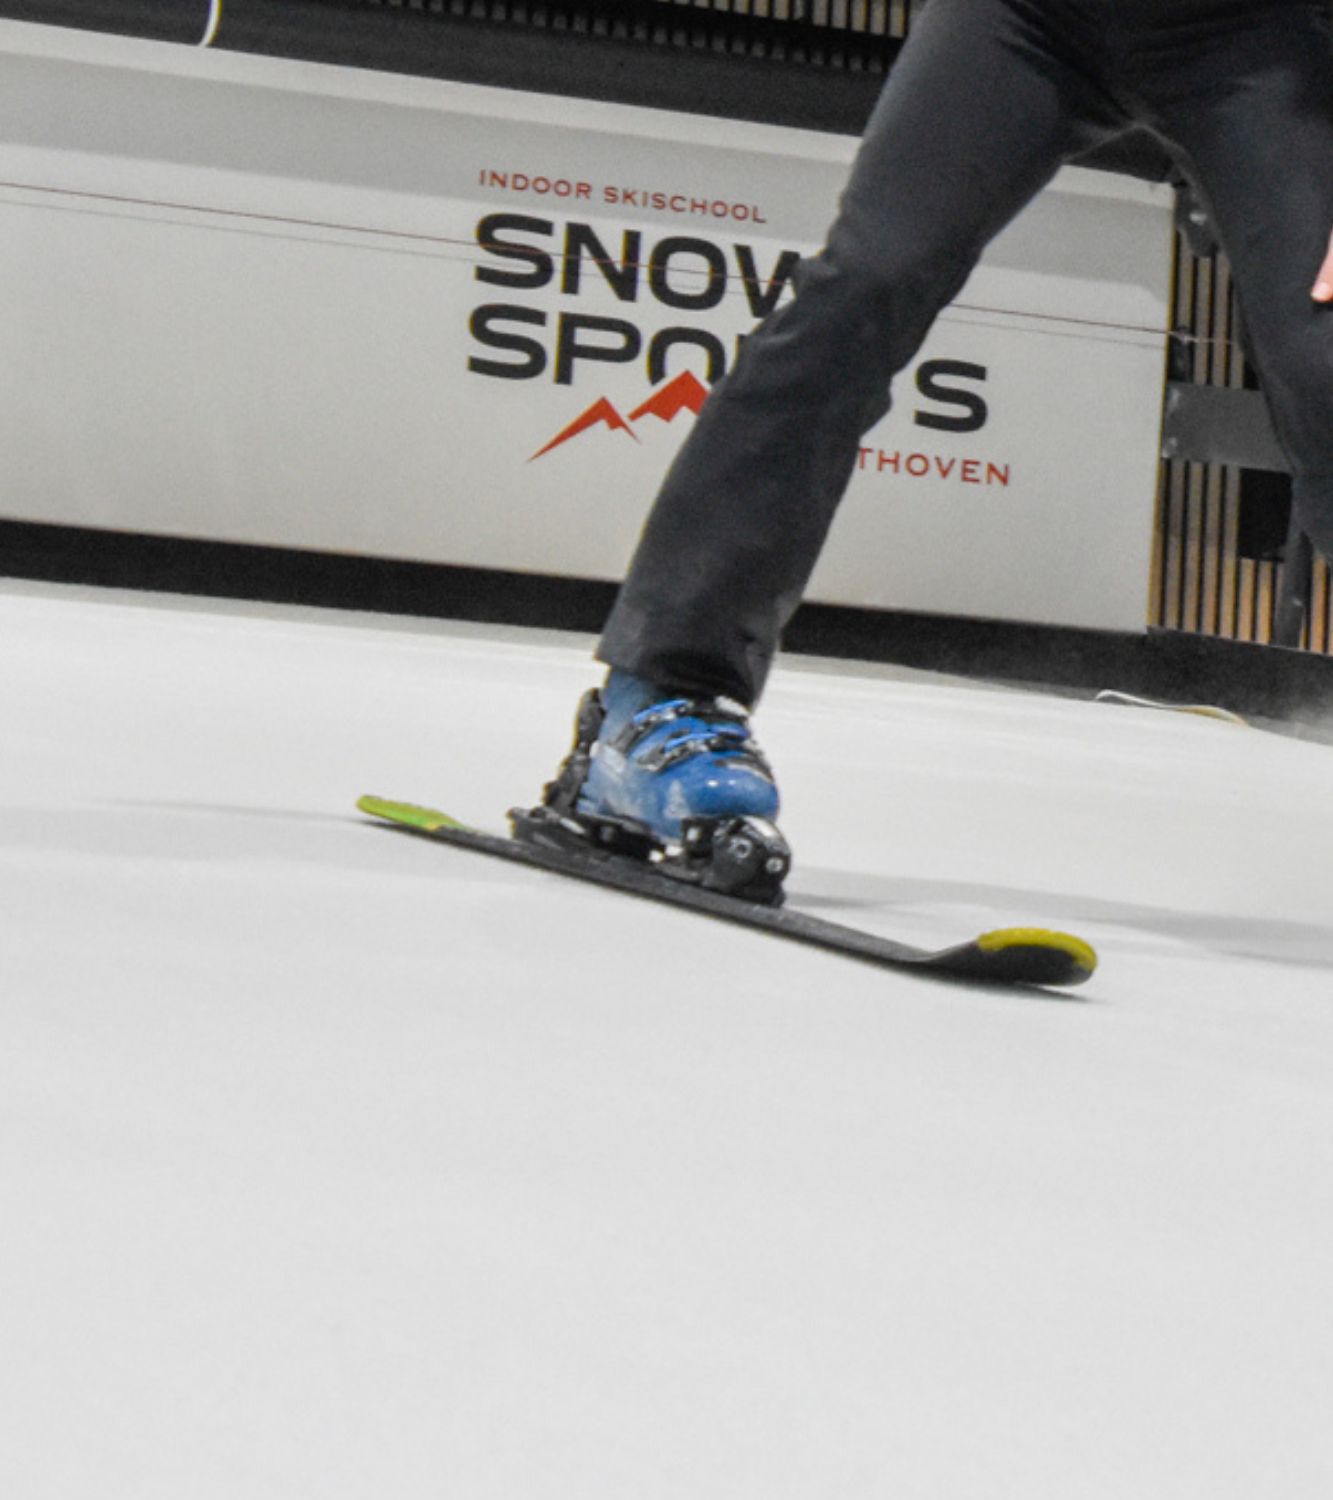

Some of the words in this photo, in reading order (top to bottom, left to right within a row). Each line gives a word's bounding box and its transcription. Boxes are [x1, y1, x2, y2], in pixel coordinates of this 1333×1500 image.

[478, 169, 593, 199] INDOOR
[603, 186, 768, 224] SKISCHOOL
[467, 302, 988, 434] SPOS
[858, 447, 1009, 487] THOVEN
